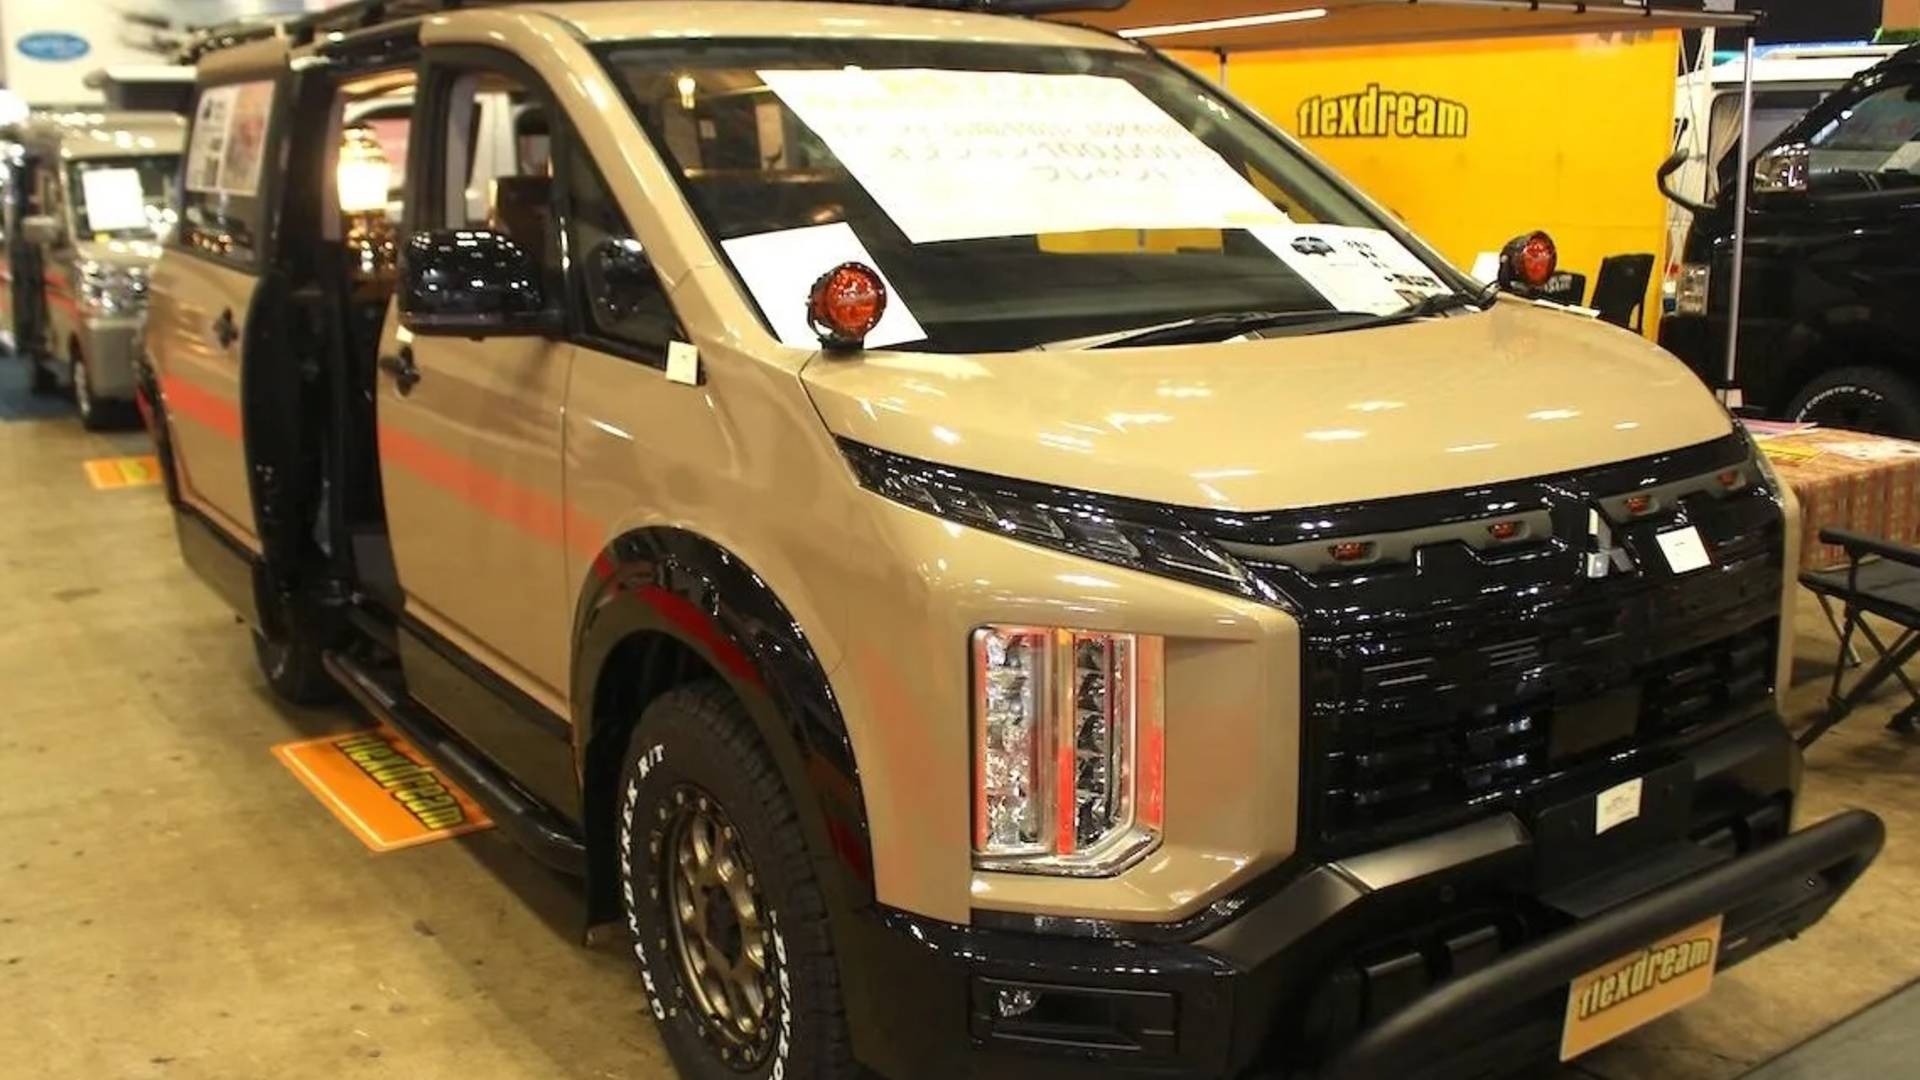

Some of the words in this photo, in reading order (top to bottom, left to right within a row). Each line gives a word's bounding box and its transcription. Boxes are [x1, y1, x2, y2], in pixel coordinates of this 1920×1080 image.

[1298, 82, 1468, 138] flexdream
[635, 743, 666, 779] R/T
[767, 927, 791, 1080] DUNLO
[1577, 937, 1713, 1021] flexdream
